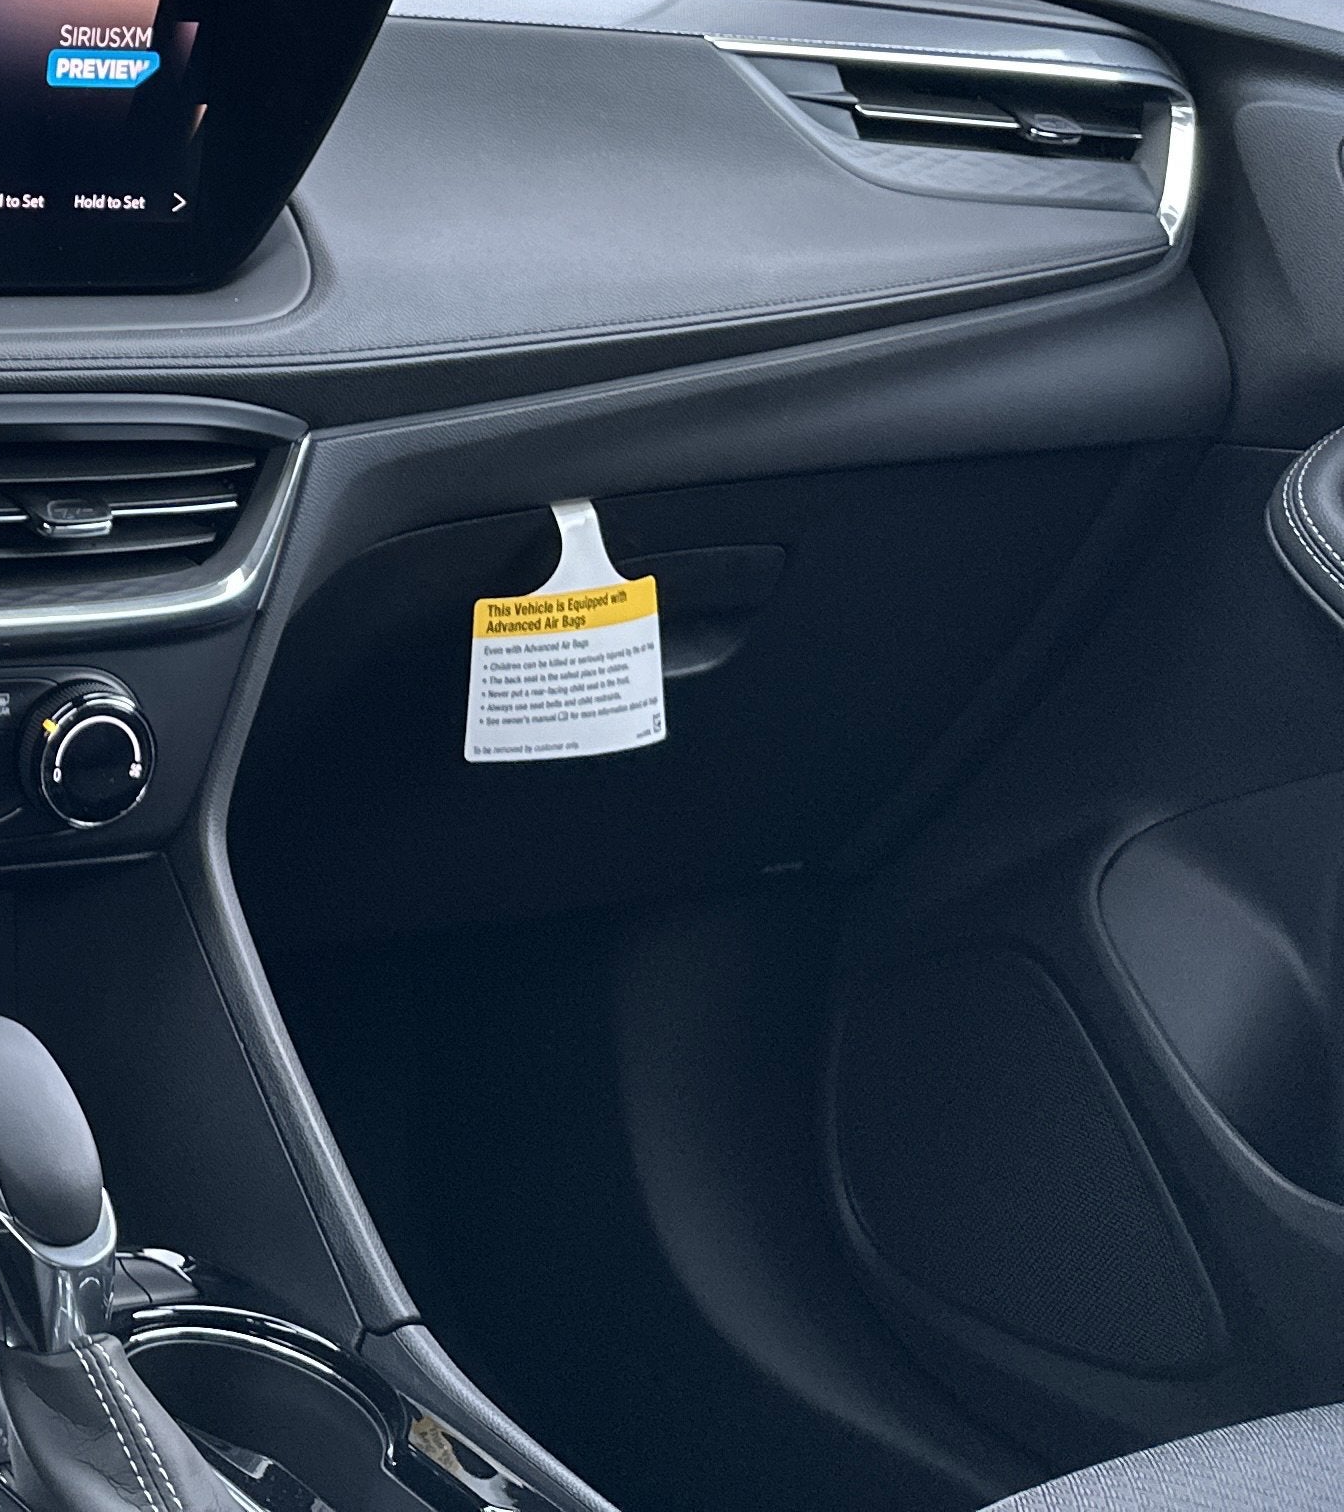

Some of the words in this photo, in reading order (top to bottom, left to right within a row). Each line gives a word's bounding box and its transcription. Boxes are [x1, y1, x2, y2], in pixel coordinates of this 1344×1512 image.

[60, 24, 153, 48] SIRIUSXM
[55, 57, 151, 80] PREVIEW
[5, 194, 20, 208] to
[22, 194, 45, 209] Set
[73, 194, 105, 209] Hold
[107, 195, 121, 209] to
[123, 195, 145, 210] Set
[487, 603, 511, 618] This
[514, 600, 553, 616] Vehicle
[556, 599, 564, 613] is
[567, 592, 609, 612] Equipped
[611, 590, 628, 604] with
[486, 617, 542, 634] Advanced
[544, 615, 559, 629] Air
[562, 614, 586, 630] Bags
[524, 642, 559, 653] Advanced
